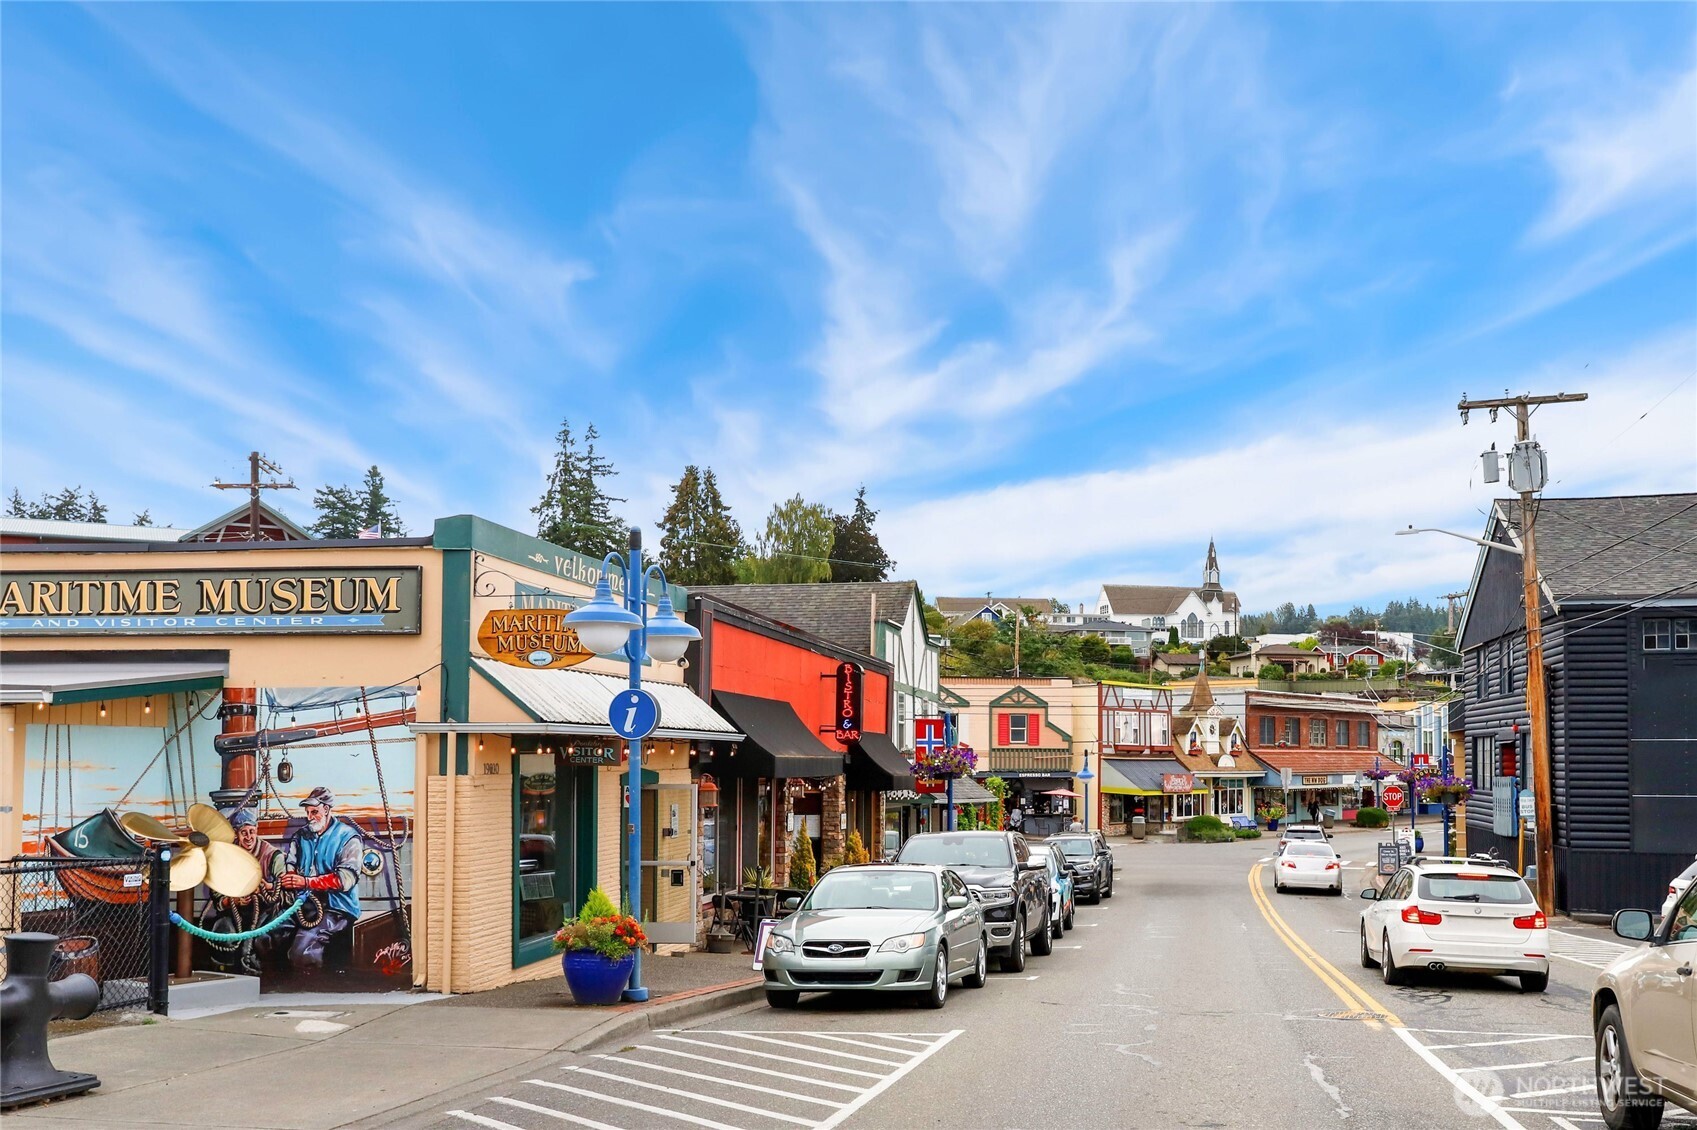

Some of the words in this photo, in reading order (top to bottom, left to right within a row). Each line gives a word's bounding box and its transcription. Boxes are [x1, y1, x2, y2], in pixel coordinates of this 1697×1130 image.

[199, 576, 402, 614] MUSEUM
[31, 619, 80, 628] AND
[95, 617, 197, 628] VISITOR
[216, 615, 324, 627] CENTER
[492, 613, 577, 634] MARITI
[498, 633, 582, 654] MUSEUM
[842, 664, 853, 718] BISTRO
[842, 719, 852, 729] &
[836, 730, 859, 740] BAR
[560, 746, 616, 762] VSITOR
[569, 756, 604, 765] CENTER
[1383, 792, 1402, 801] STOP
